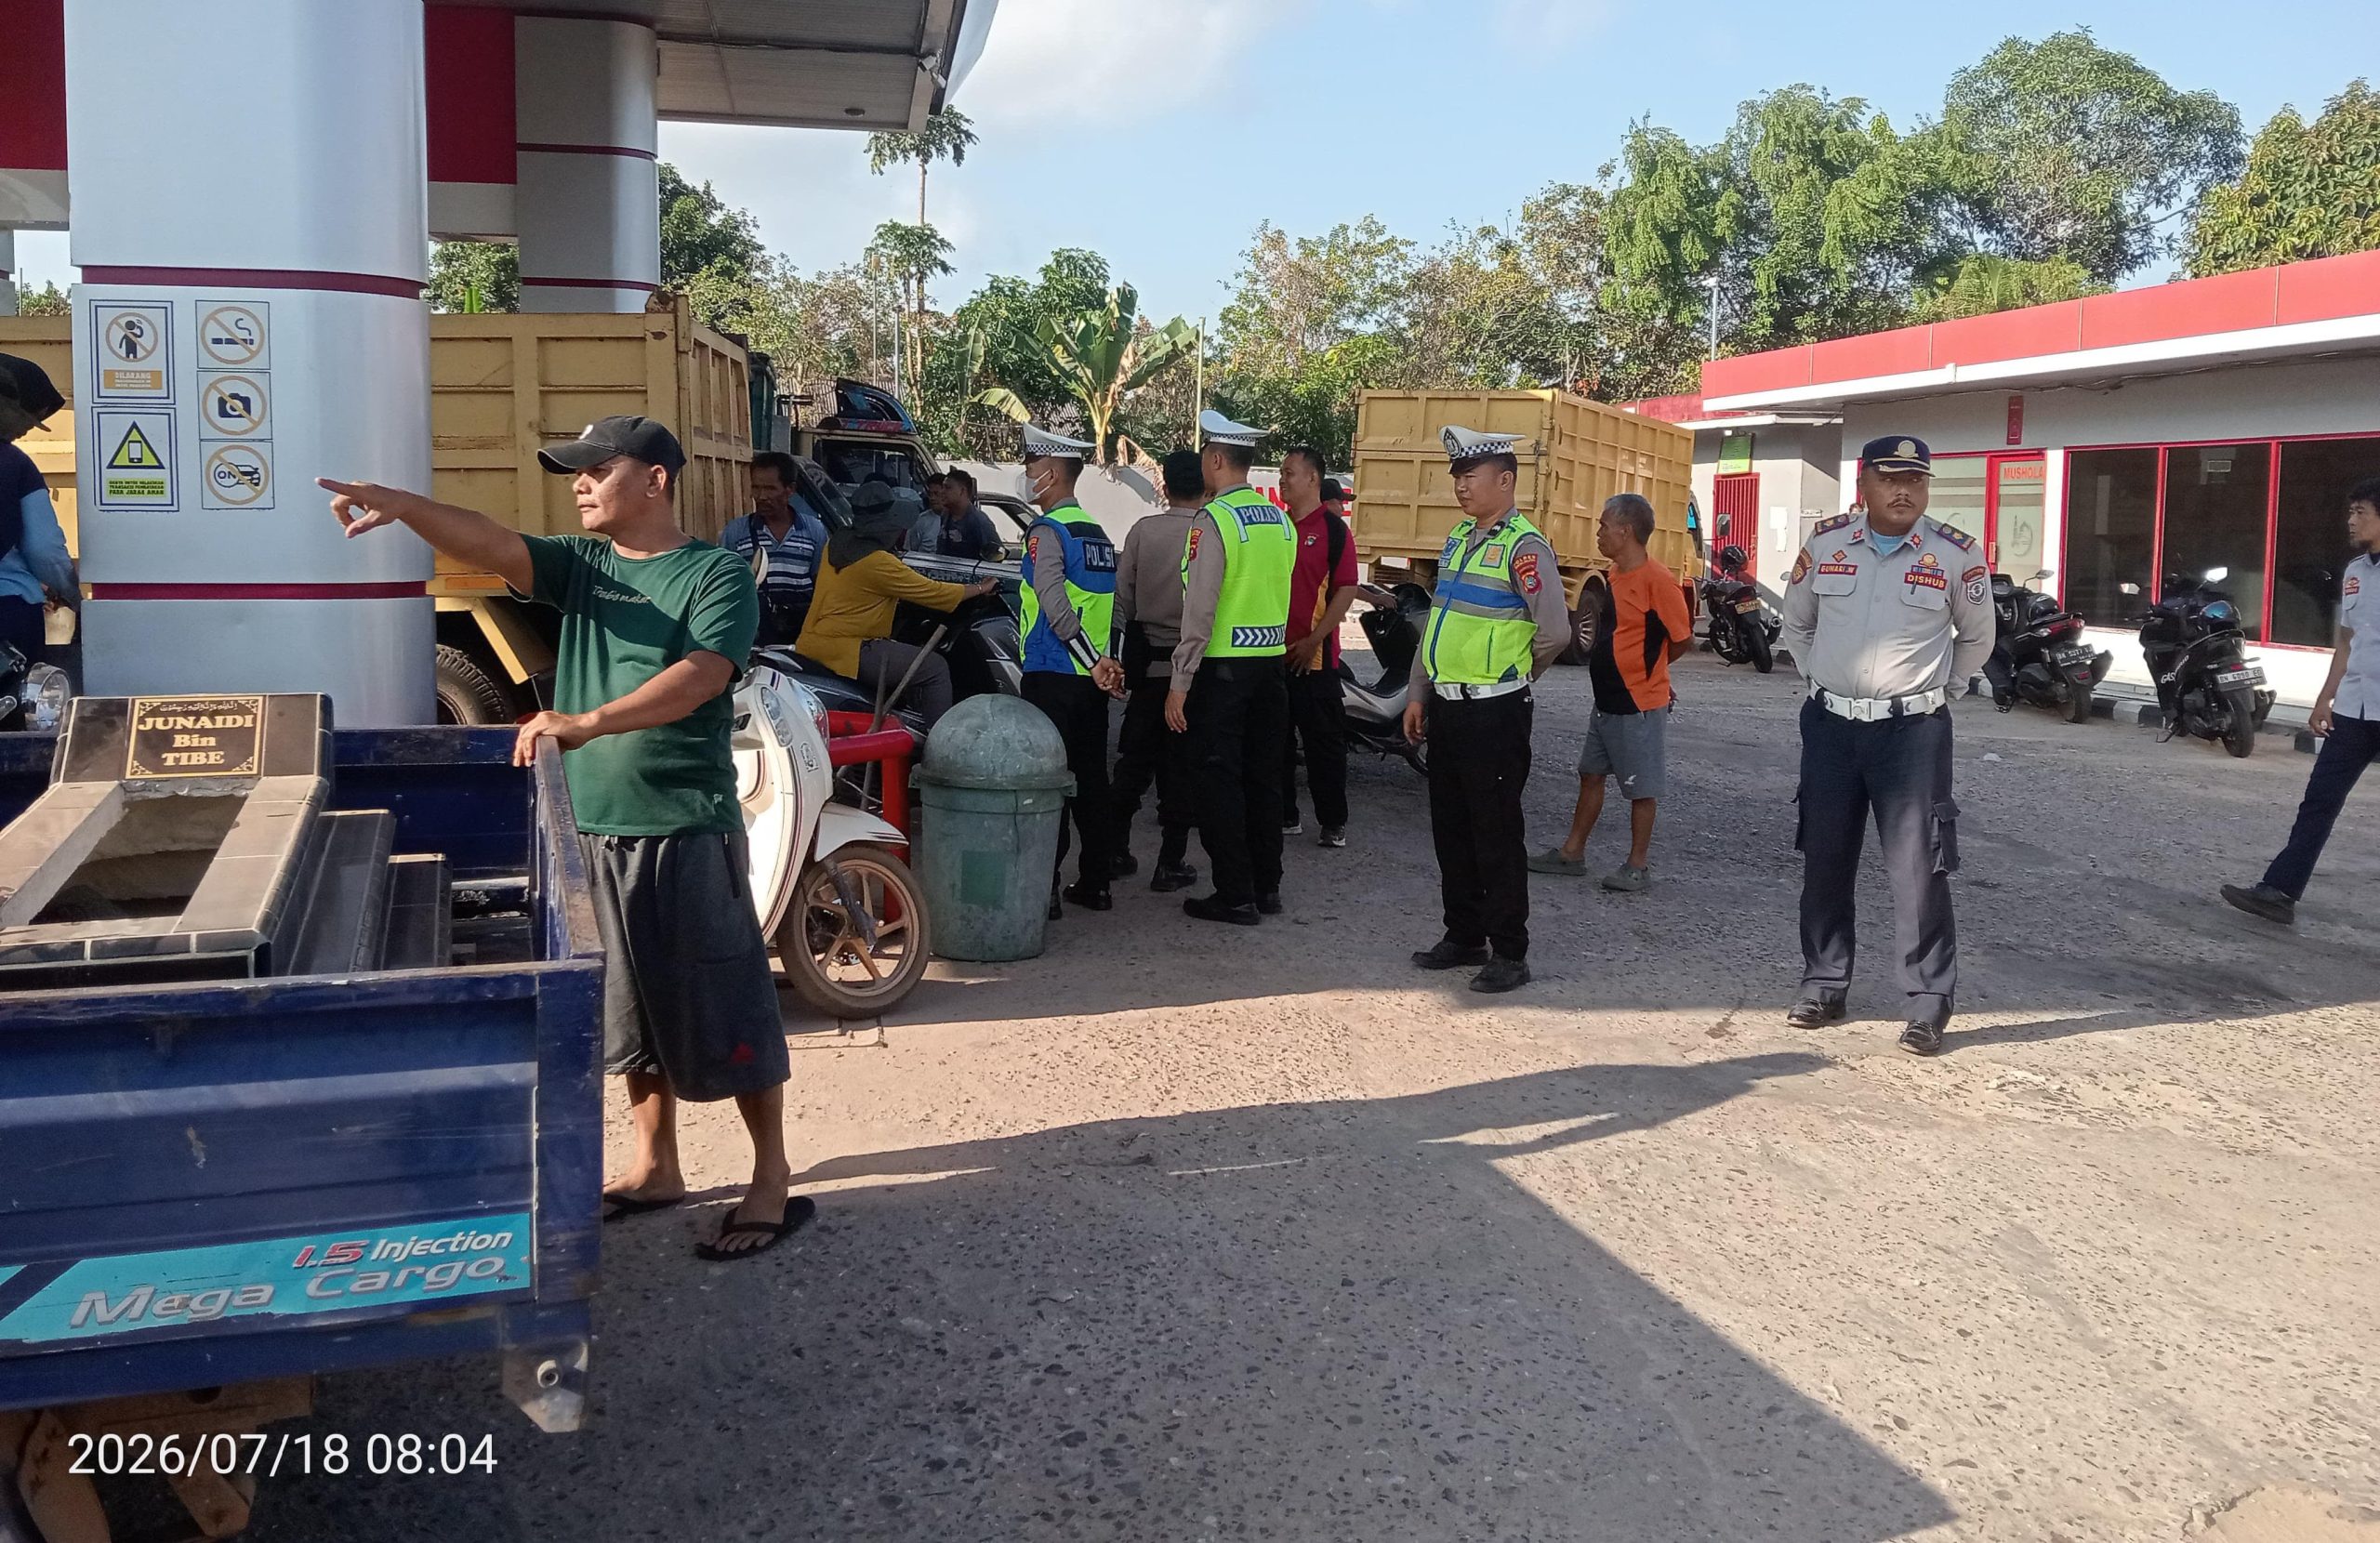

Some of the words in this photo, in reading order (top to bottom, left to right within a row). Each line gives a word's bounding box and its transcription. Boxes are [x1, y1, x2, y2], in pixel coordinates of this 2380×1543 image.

[1085, 544, 1115, 568] POLISI
[1907, 574, 1945, 588] DISHUB
[138, 715, 255, 730] JUNAIDI
[172, 734, 216, 747] Bin
[161, 751, 225, 766] TIBE
[370, 1231, 513, 1262] Injection
[70, 1282, 273, 1327] Mega
[306, 1256, 505, 1299] Cargo
